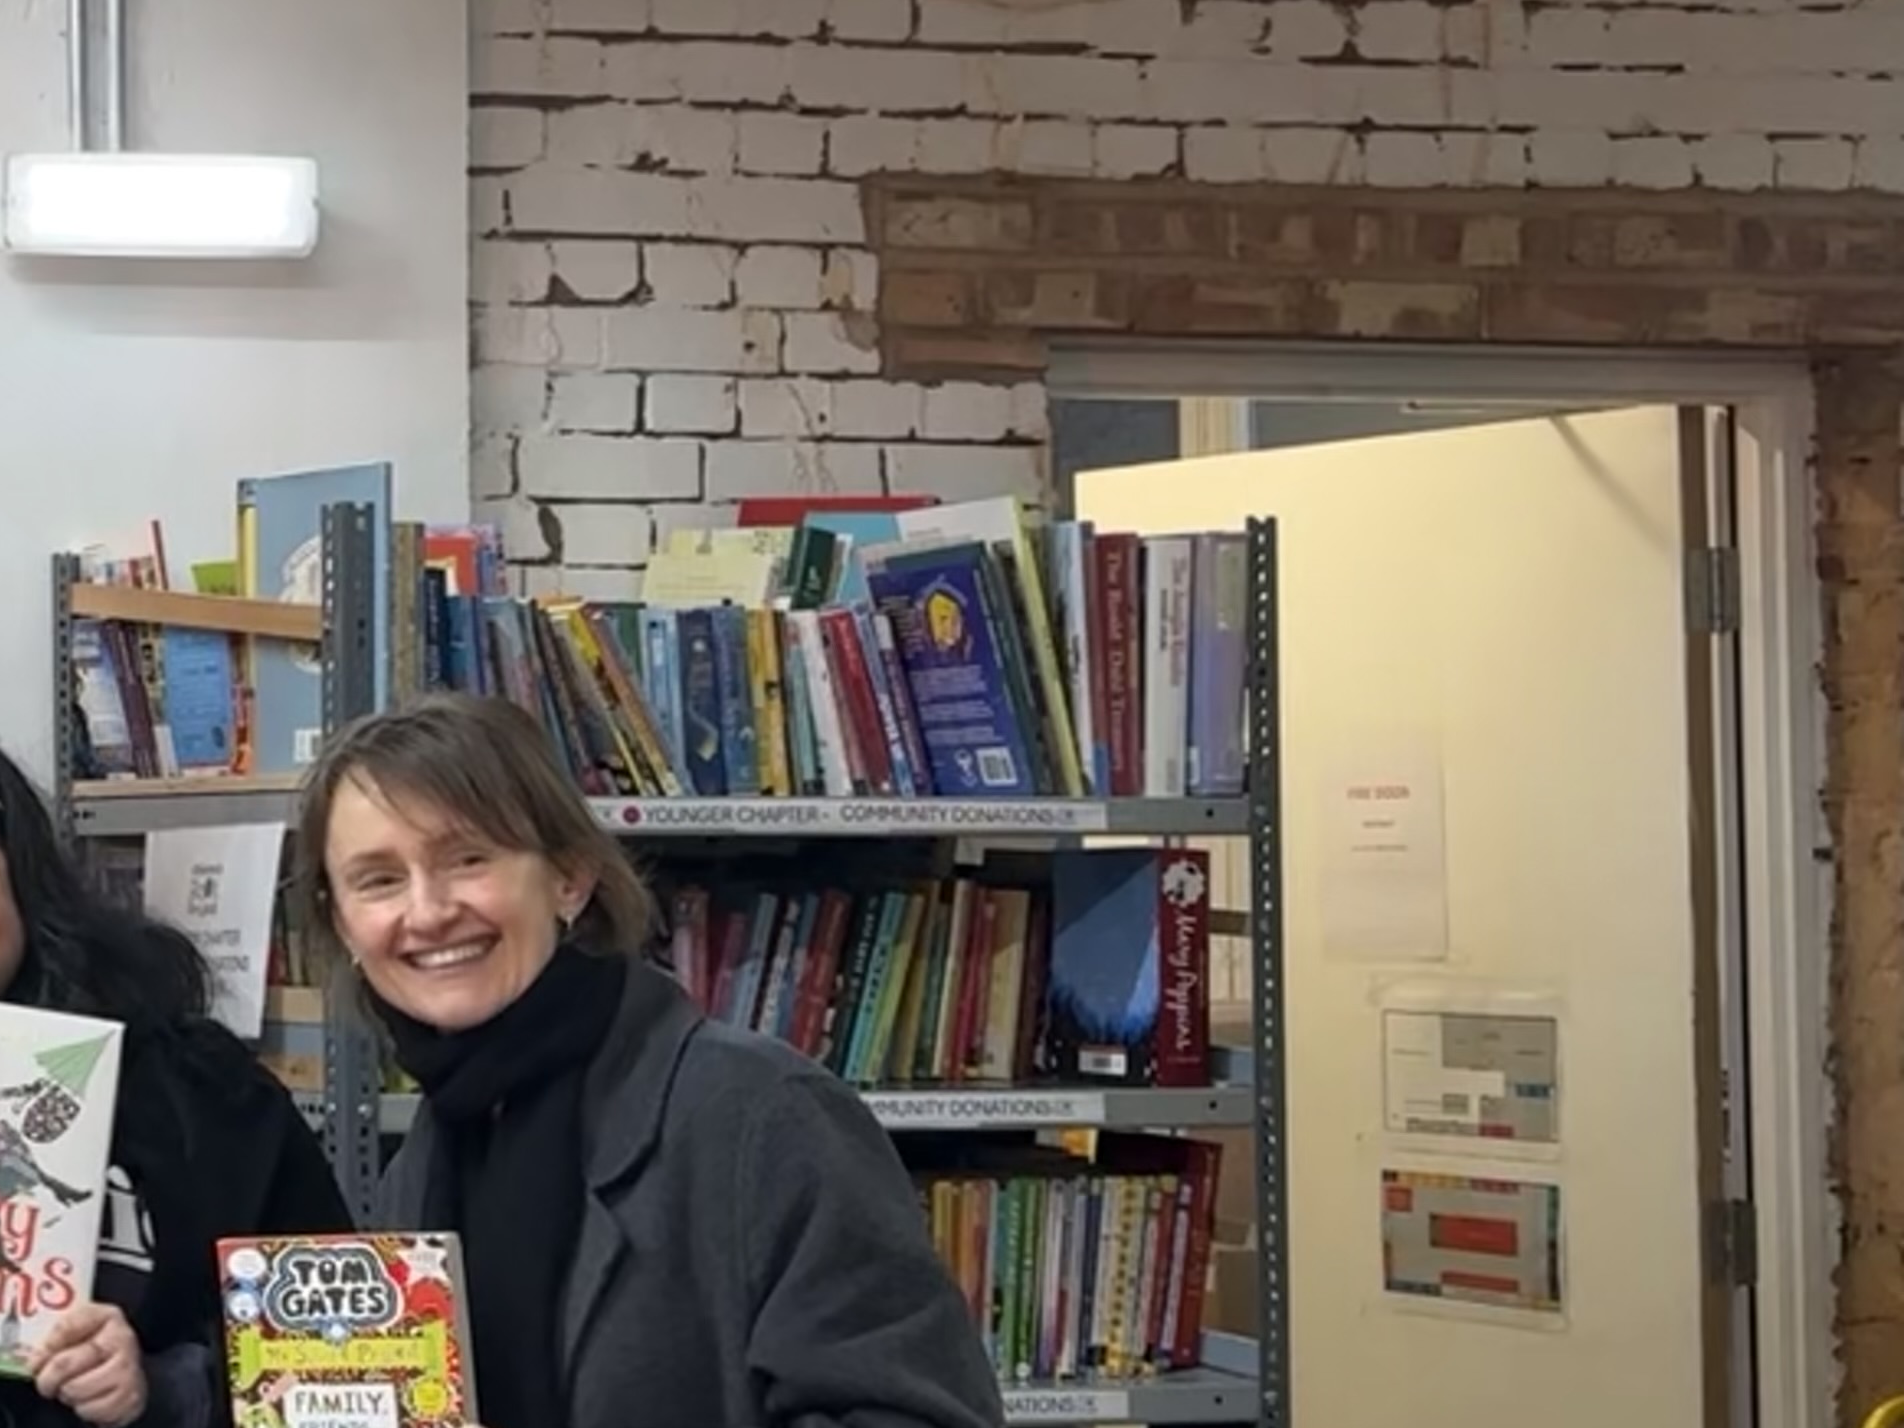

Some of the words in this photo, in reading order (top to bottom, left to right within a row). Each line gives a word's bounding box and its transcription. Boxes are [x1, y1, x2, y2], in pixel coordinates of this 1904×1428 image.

[645, 806, 733, 823] YOUNGER
[737, 806, 819, 824] CHAPTER
[840, 806, 946, 824] COMMUNITY
[951, 807, 1056, 824] DONATIONS
[950, 1098, 1050, 1117] DONATIONS
[291, 1259, 378, 1284] TOM
[281, 1286, 386, 1317] GATES
